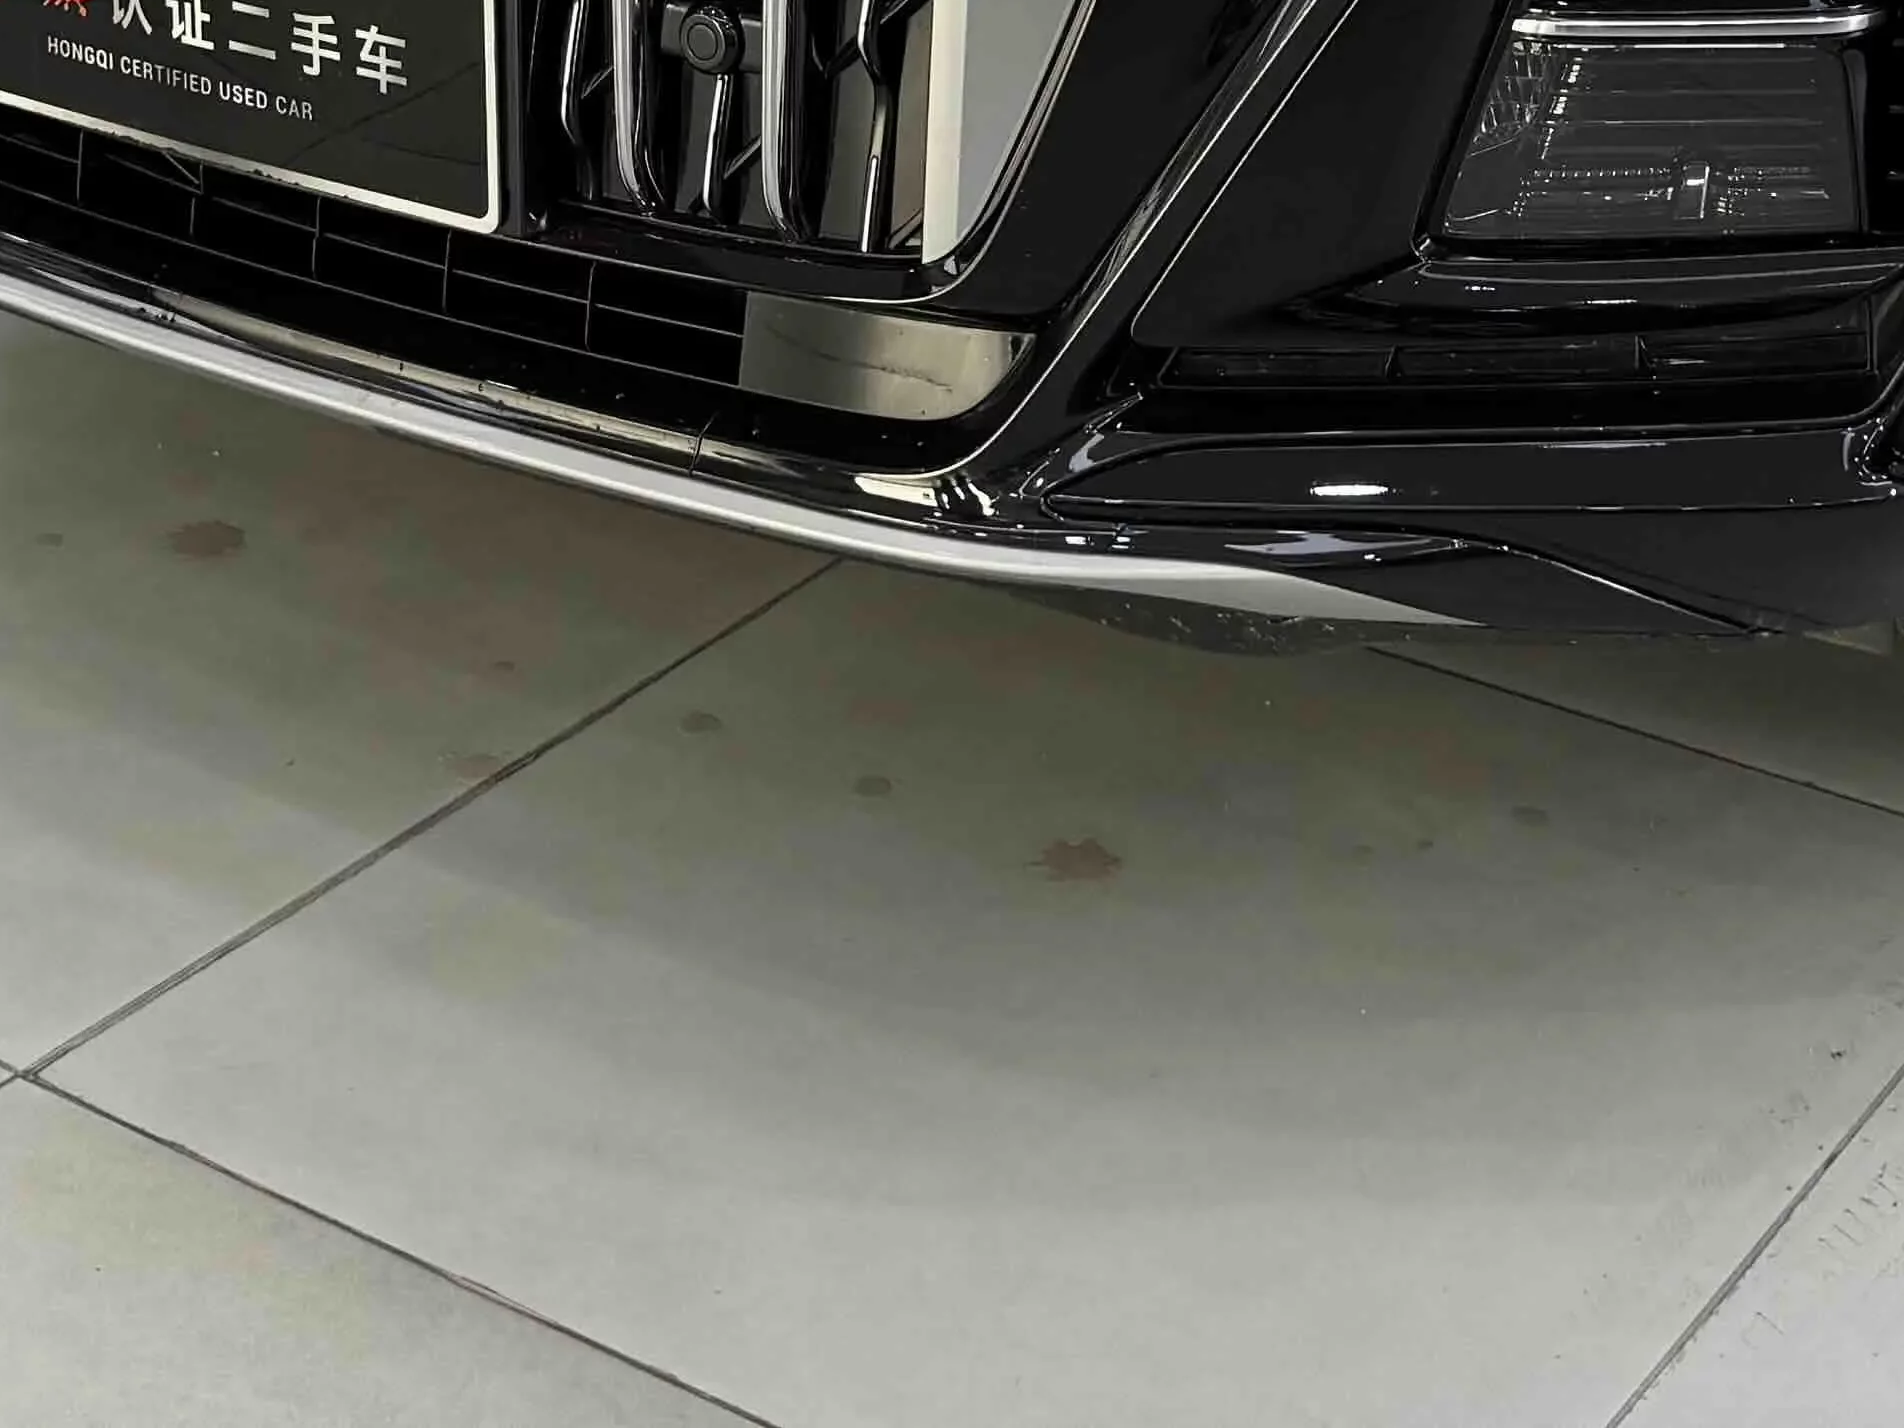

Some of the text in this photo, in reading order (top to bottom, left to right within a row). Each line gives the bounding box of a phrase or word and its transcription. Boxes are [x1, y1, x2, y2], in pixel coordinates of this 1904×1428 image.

[46, 34, 314, 122] HONGQI CERTIFIED USED CAR
